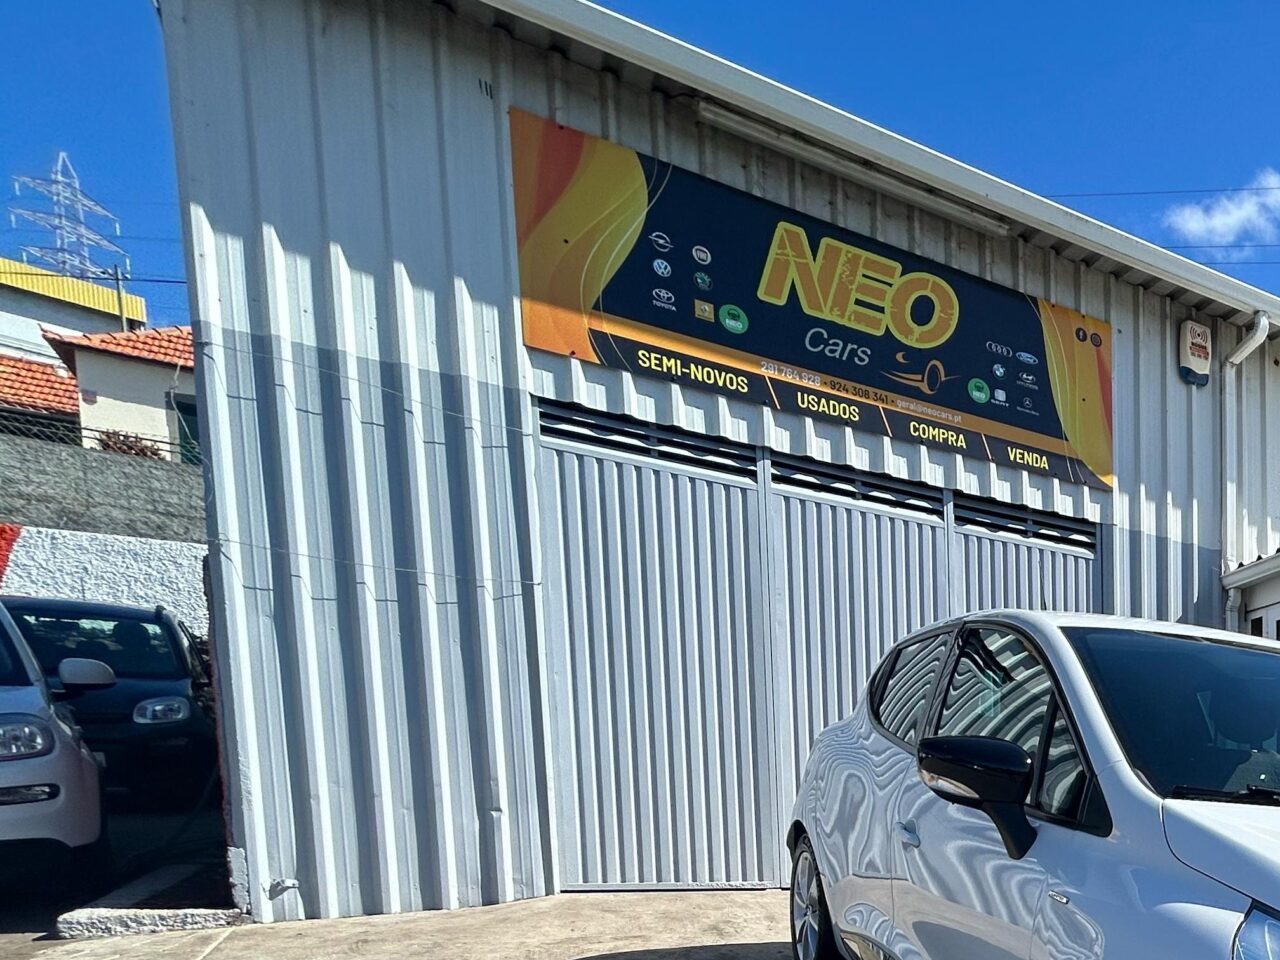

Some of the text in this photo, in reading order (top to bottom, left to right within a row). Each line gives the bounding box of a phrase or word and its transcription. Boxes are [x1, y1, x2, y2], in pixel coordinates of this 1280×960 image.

[757, 221, 959, 349] NEO
[652, 300, 677, 312] TOYOTA
[805, 327, 871, 366] Cars
[638, 349, 749, 393] SEMI-NOVOS
[760, 361, 963, 424] 291 764 928 924 308 341 geral@neocars.pt
[797, 391, 860, 422] USADOS
[909, 421, 967, 450] COMPRA
[1007, 446, 1049, 470] VENDA
